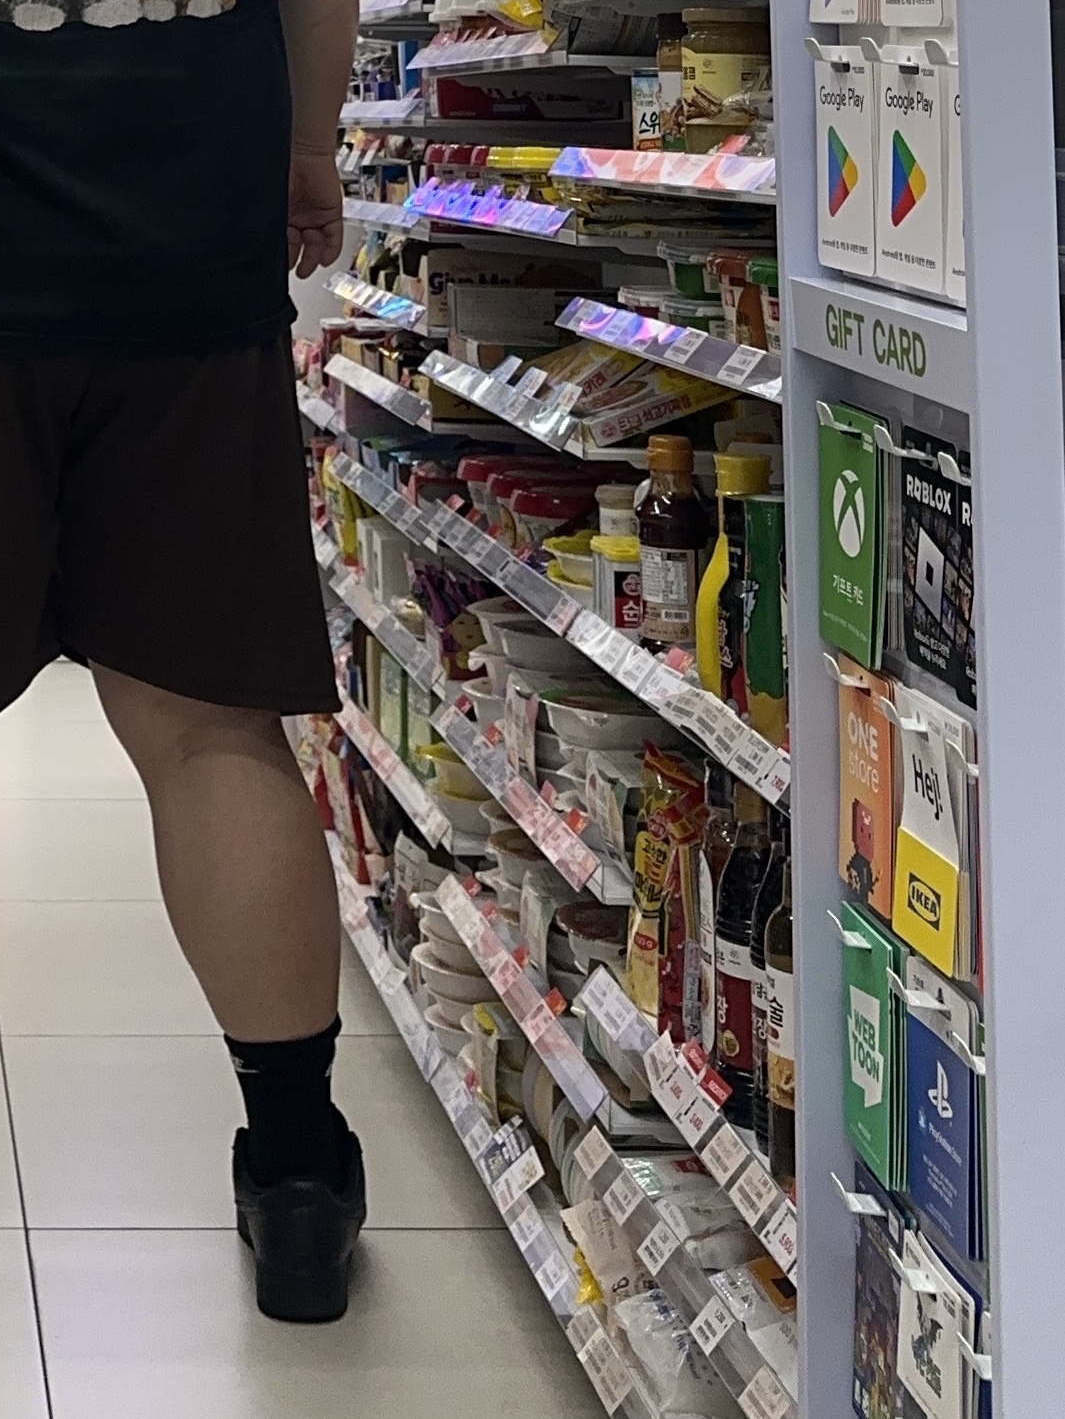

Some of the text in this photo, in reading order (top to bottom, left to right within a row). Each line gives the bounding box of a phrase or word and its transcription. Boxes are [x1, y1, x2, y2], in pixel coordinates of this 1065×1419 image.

[819, 85, 865, 113] Google Play
[885, 86, 934, 119] Google Play
[825, 303, 927, 378] GIFT CARD
[906, 473, 952, 516] ROBLOX
[847, 710, 879, 762] ONE
[848, 749, 880, 794] store
[912, 753, 944, 821] Hej!
[910, 885, 938, 918] IKEA
[853, 1007, 876, 1052] WEB
[851, 1031, 880, 1084] TOON
